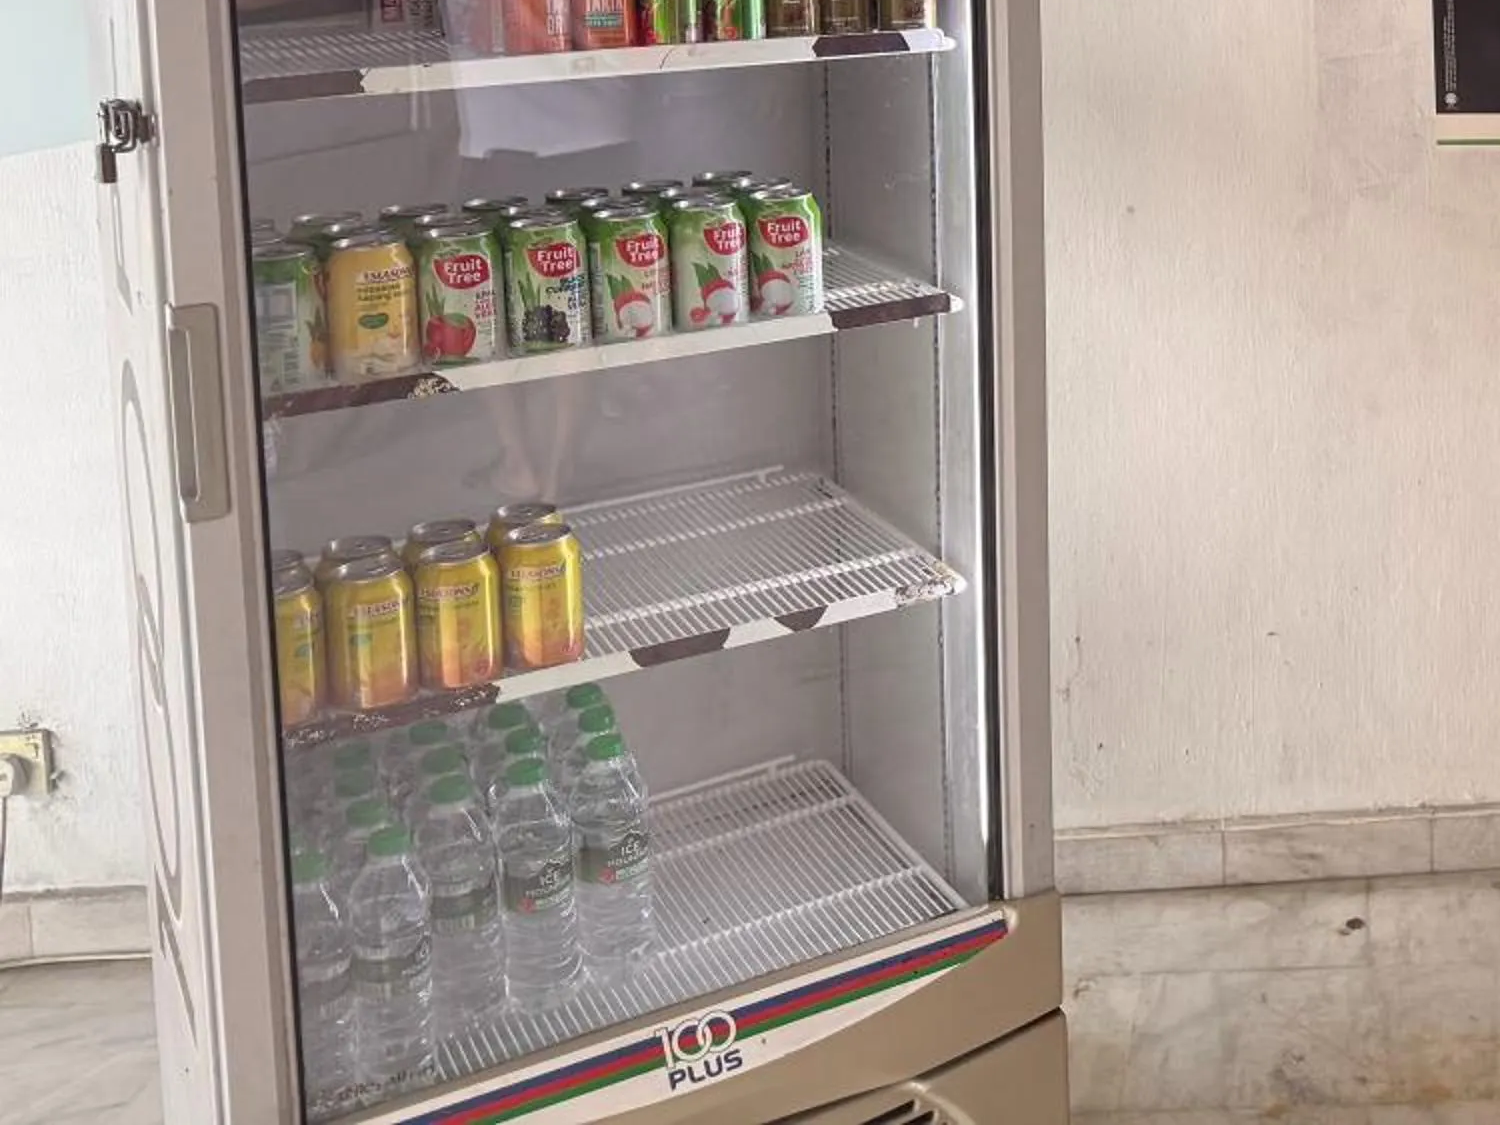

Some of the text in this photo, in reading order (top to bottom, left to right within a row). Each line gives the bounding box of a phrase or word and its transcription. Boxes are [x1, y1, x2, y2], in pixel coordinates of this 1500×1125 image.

[767, 218, 802, 234] Fruit
[626, 237, 659, 252] Fruit
[770, 231, 800, 244] Tree
[537, 247, 574, 262] Fruit
[630, 249, 658, 263] Tree
[444, 259, 483, 275] Fruit
[542, 259, 573, 272] Tree
[449, 272, 482, 285] Tree
[654, 1010, 736, 1069] 100
[668, 1048, 743, 1092] PLUS
